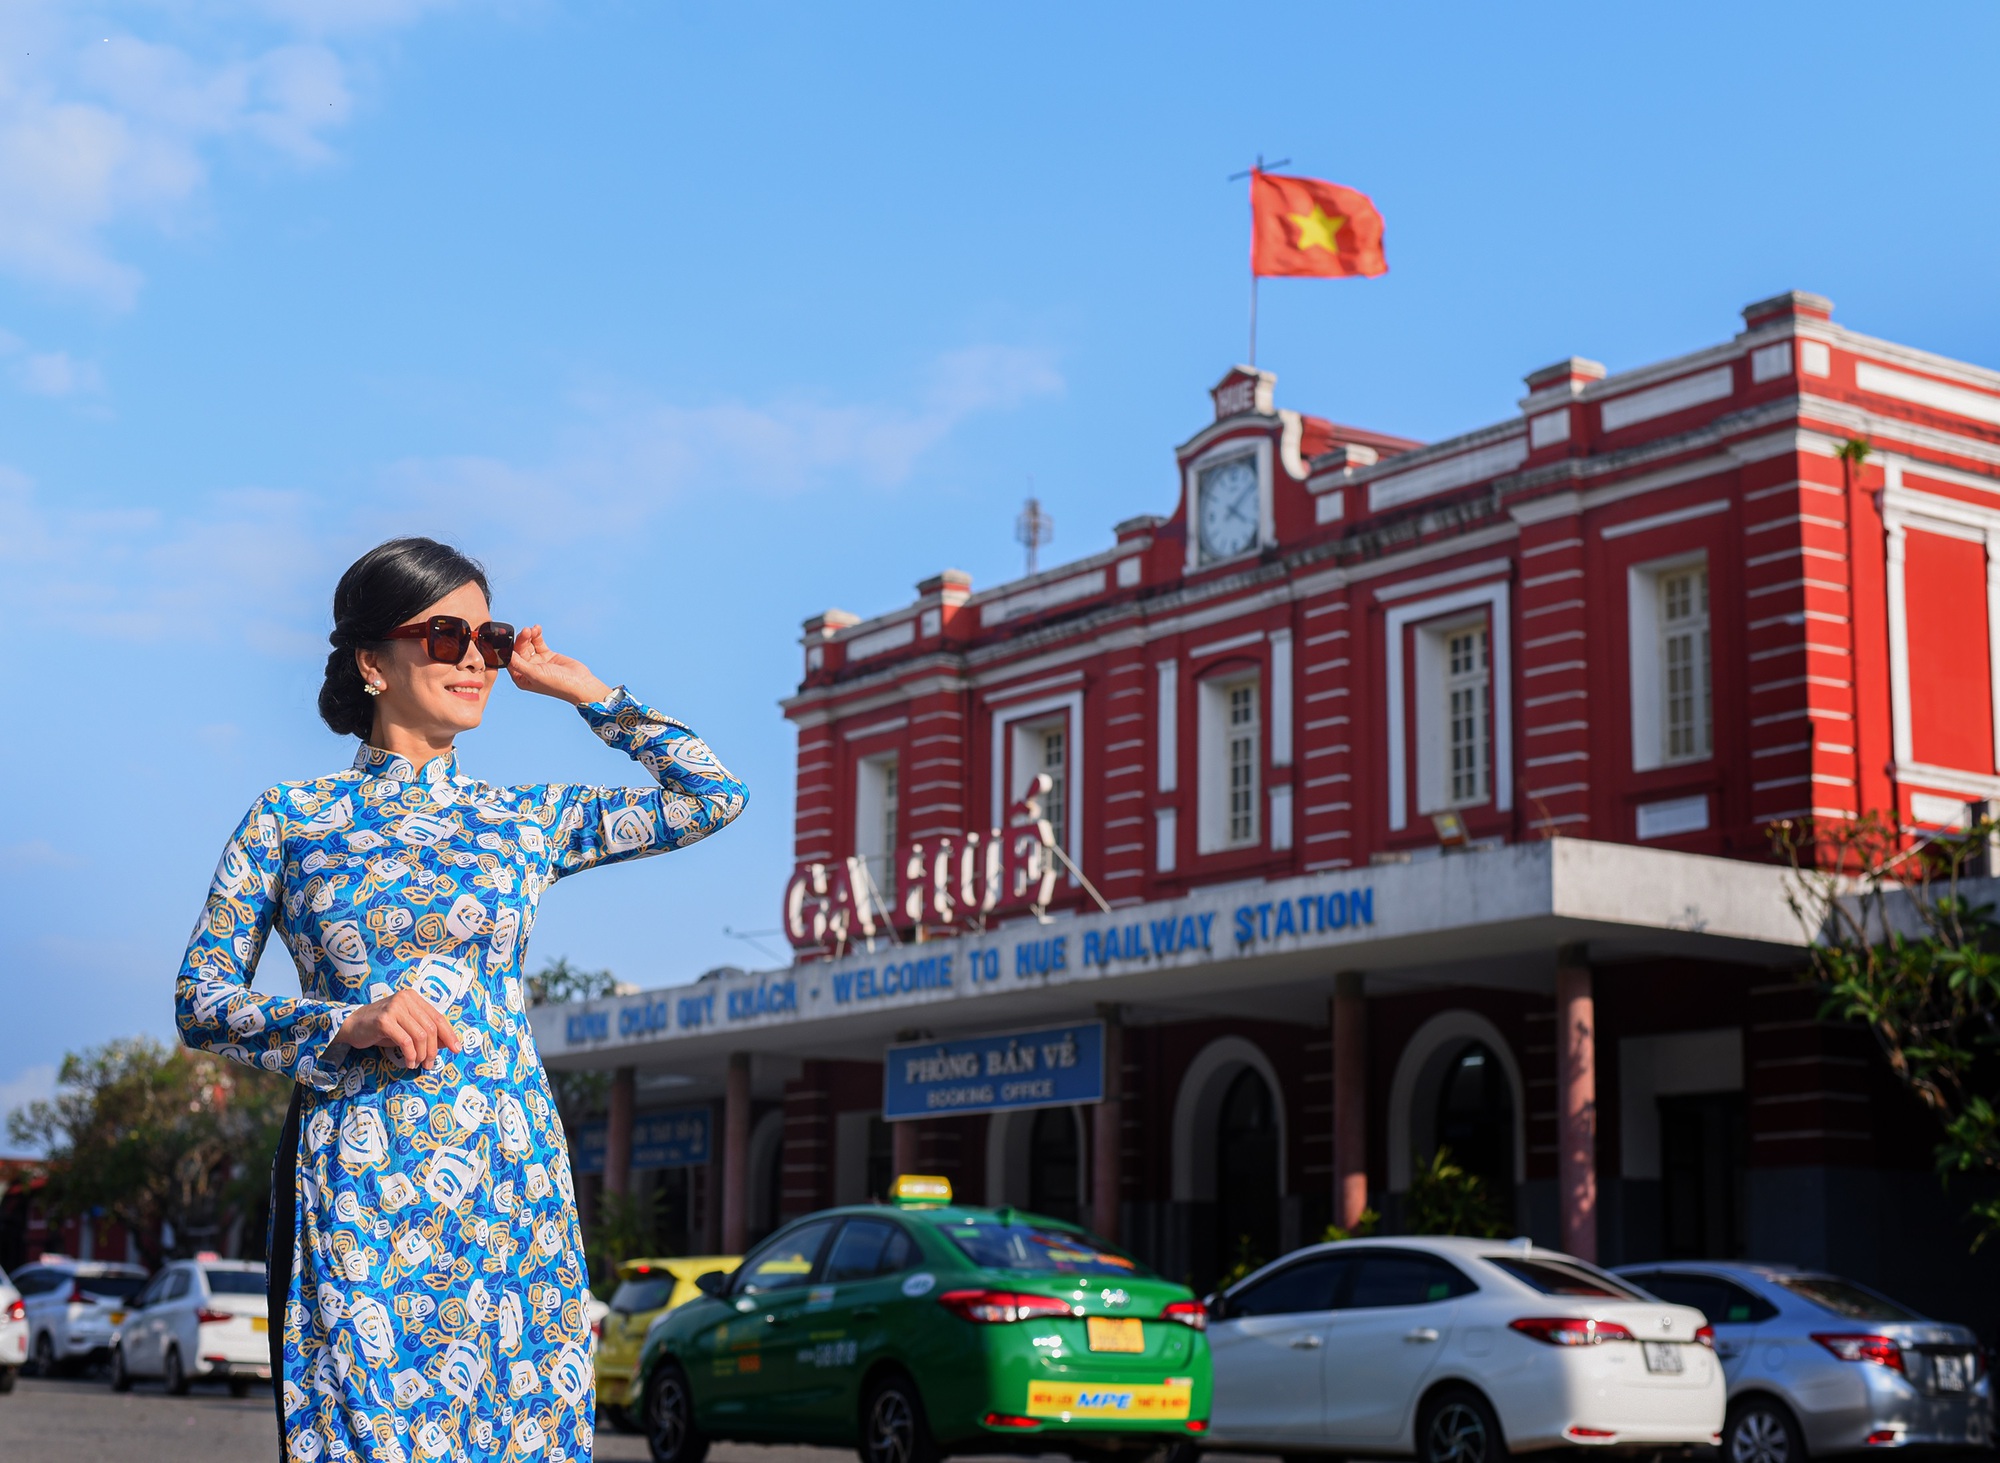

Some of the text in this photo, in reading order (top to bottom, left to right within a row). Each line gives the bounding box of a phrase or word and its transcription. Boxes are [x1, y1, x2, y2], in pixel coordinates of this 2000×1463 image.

[784, 856, 877, 949] GA
[832, 954, 954, 1004] WELCOME
[970, 947, 999, 983] TO
[1016, 936, 1067, 979] HUE
[1083, 911, 1216, 967] RAILWAY
[1233, 886, 1374, 944] STATION
[905, 1048, 979, 1085] PHÒNG
[926, 1077, 1055, 1109] BOOKING OFFICE
[1076, 1391, 1134, 1411] MPE
